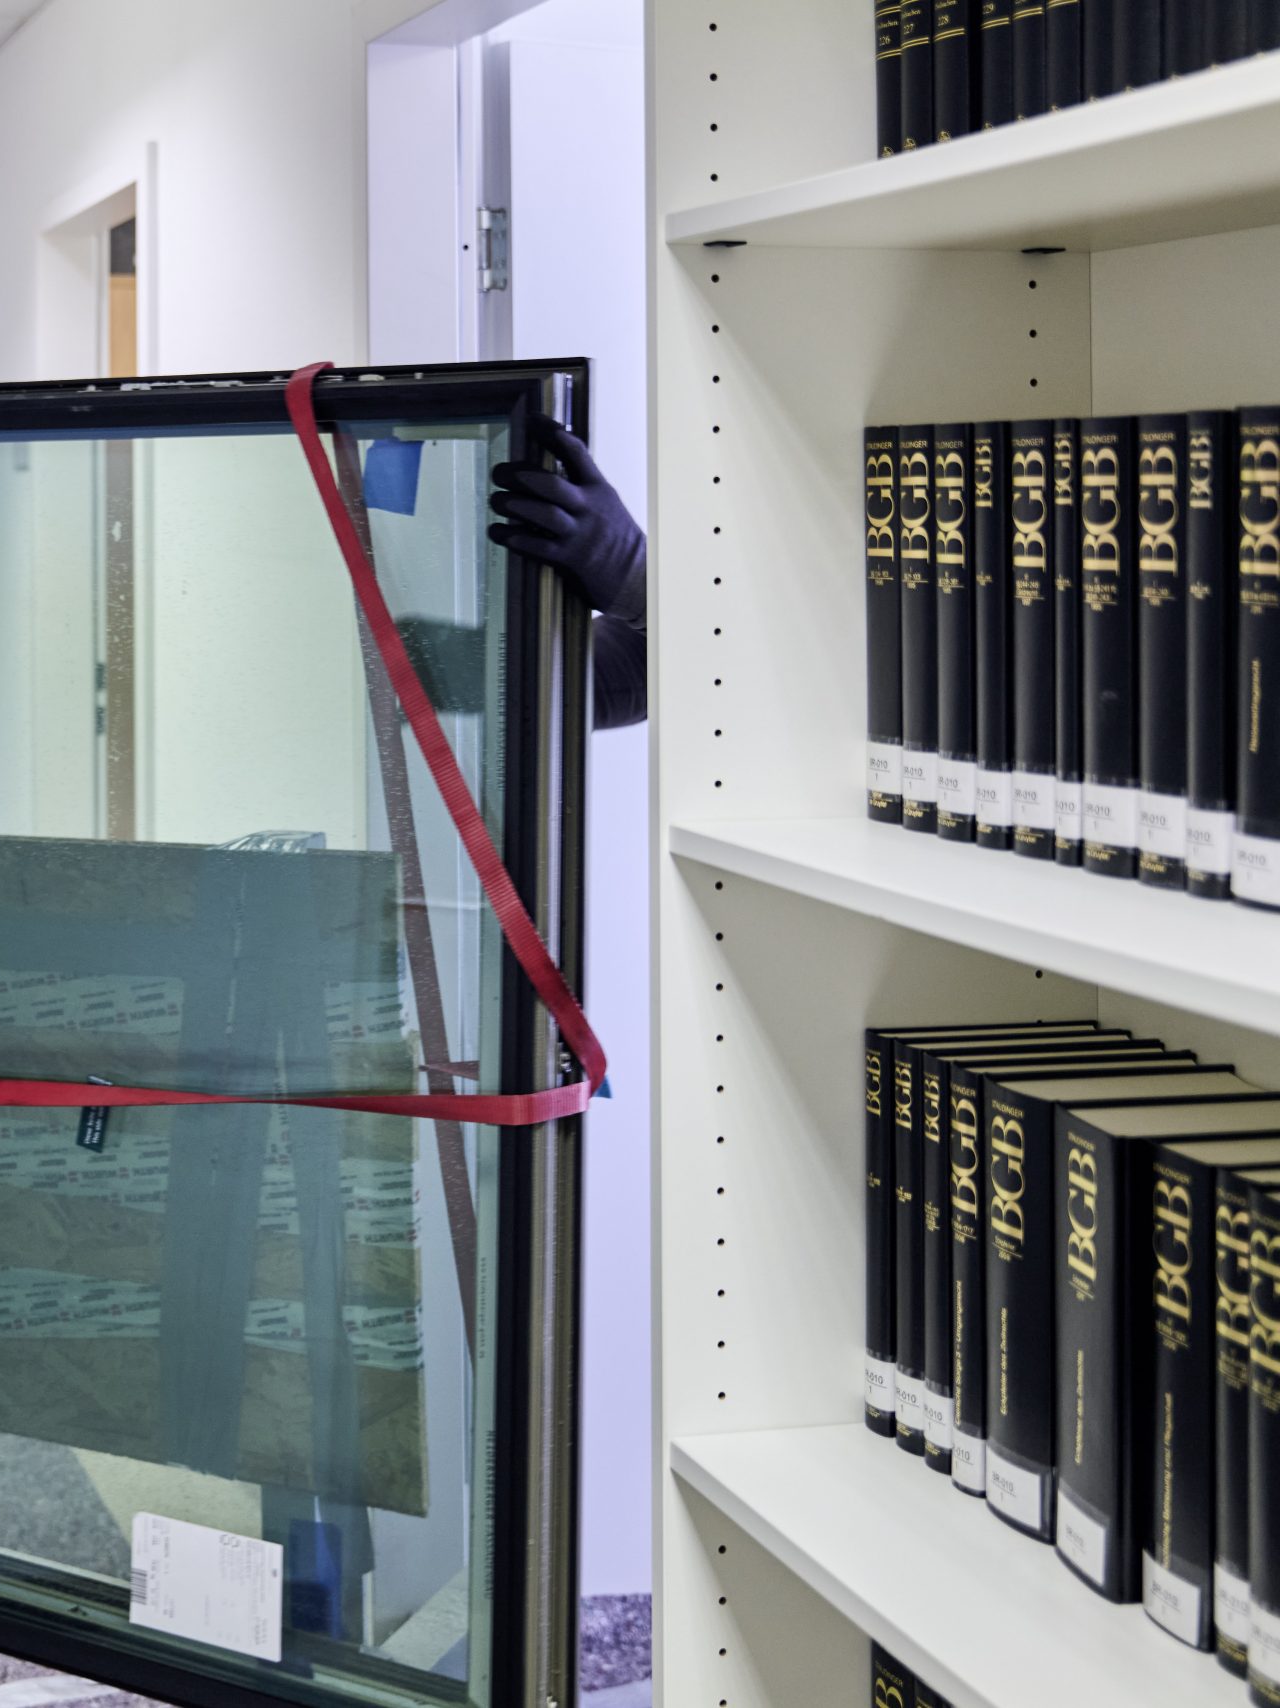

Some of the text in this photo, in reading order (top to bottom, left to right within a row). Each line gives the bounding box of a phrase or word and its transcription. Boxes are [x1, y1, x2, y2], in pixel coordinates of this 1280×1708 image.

[866, 456, 895, 562] BGB
[900, 453, 931, 564] BGB
[935, 453, 966, 569] BGB
[974, 445, 993, 509] BGB
[1011, 450, 1047, 573] BGB
[1054, 440, 1073, 506] BGB
[1081, 448, 1121, 576] BGB
[1138, 446, 1179, 578] BGB
[1189, 435, 1213, 510] BGB
[1239, 440, 1280, 580] BGB
[866, 1053, 881, 1119] BGB
[895, 1064, 912, 1132] BGB
[924, 1076, 940, 1145] BGB
[950, 1096, 979, 1221] BGB
[991, 1115, 1026, 1247] BGB
[1067, 1148, 1098, 1283] BGB
[1152, 1179, 1193, 1327] BGB
[1216, 1205, 1250, 1347] BGB
